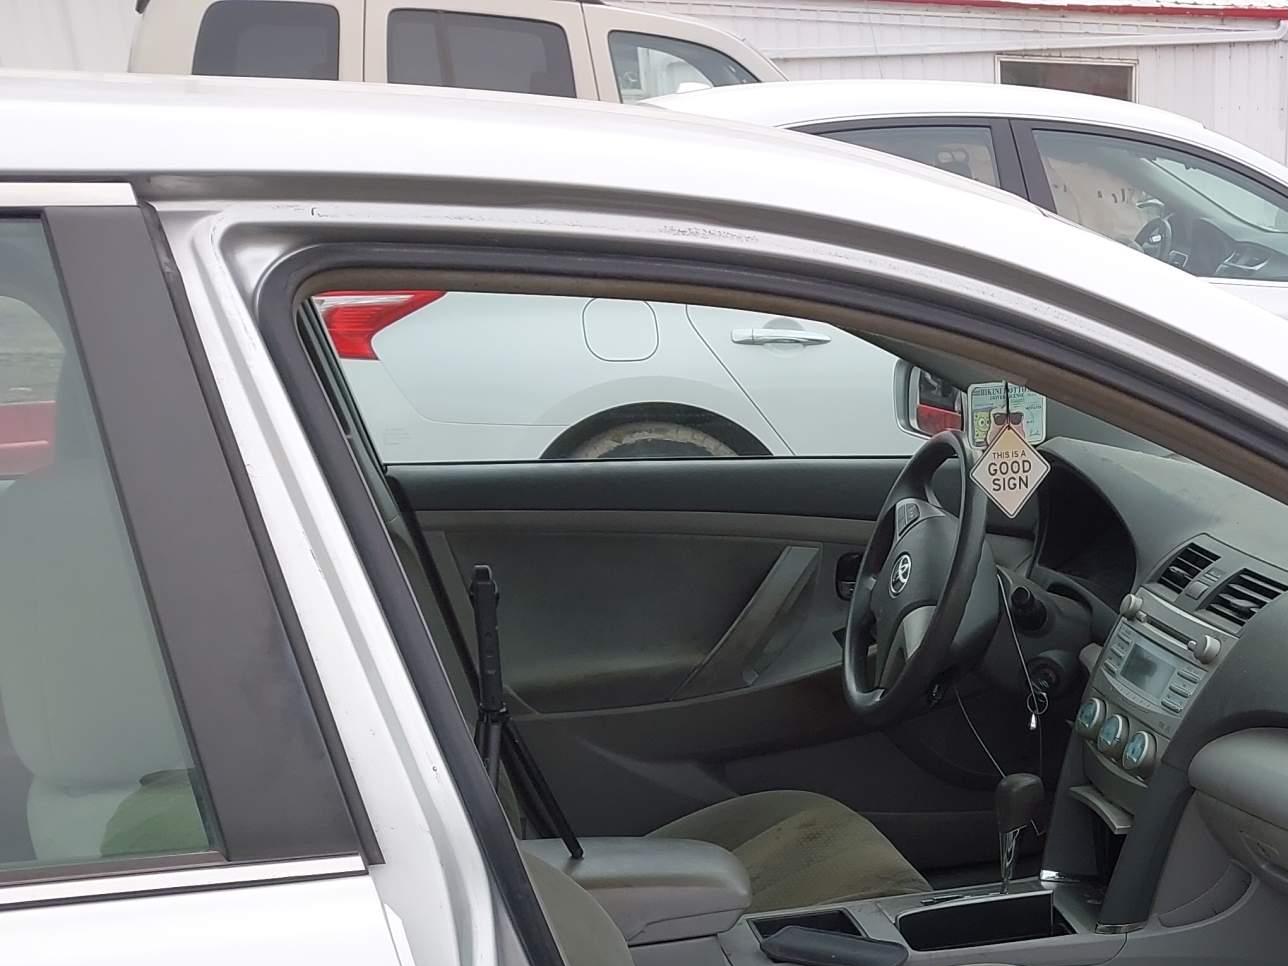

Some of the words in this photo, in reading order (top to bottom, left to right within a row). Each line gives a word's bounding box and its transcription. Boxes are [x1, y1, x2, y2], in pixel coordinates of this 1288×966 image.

[992, 451, 1010, 459] THIS
[1011, 450, 1020, 458] IS
[988, 460, 1032, 476] GOOD
[992, 475, 1029, 492] SIGN
